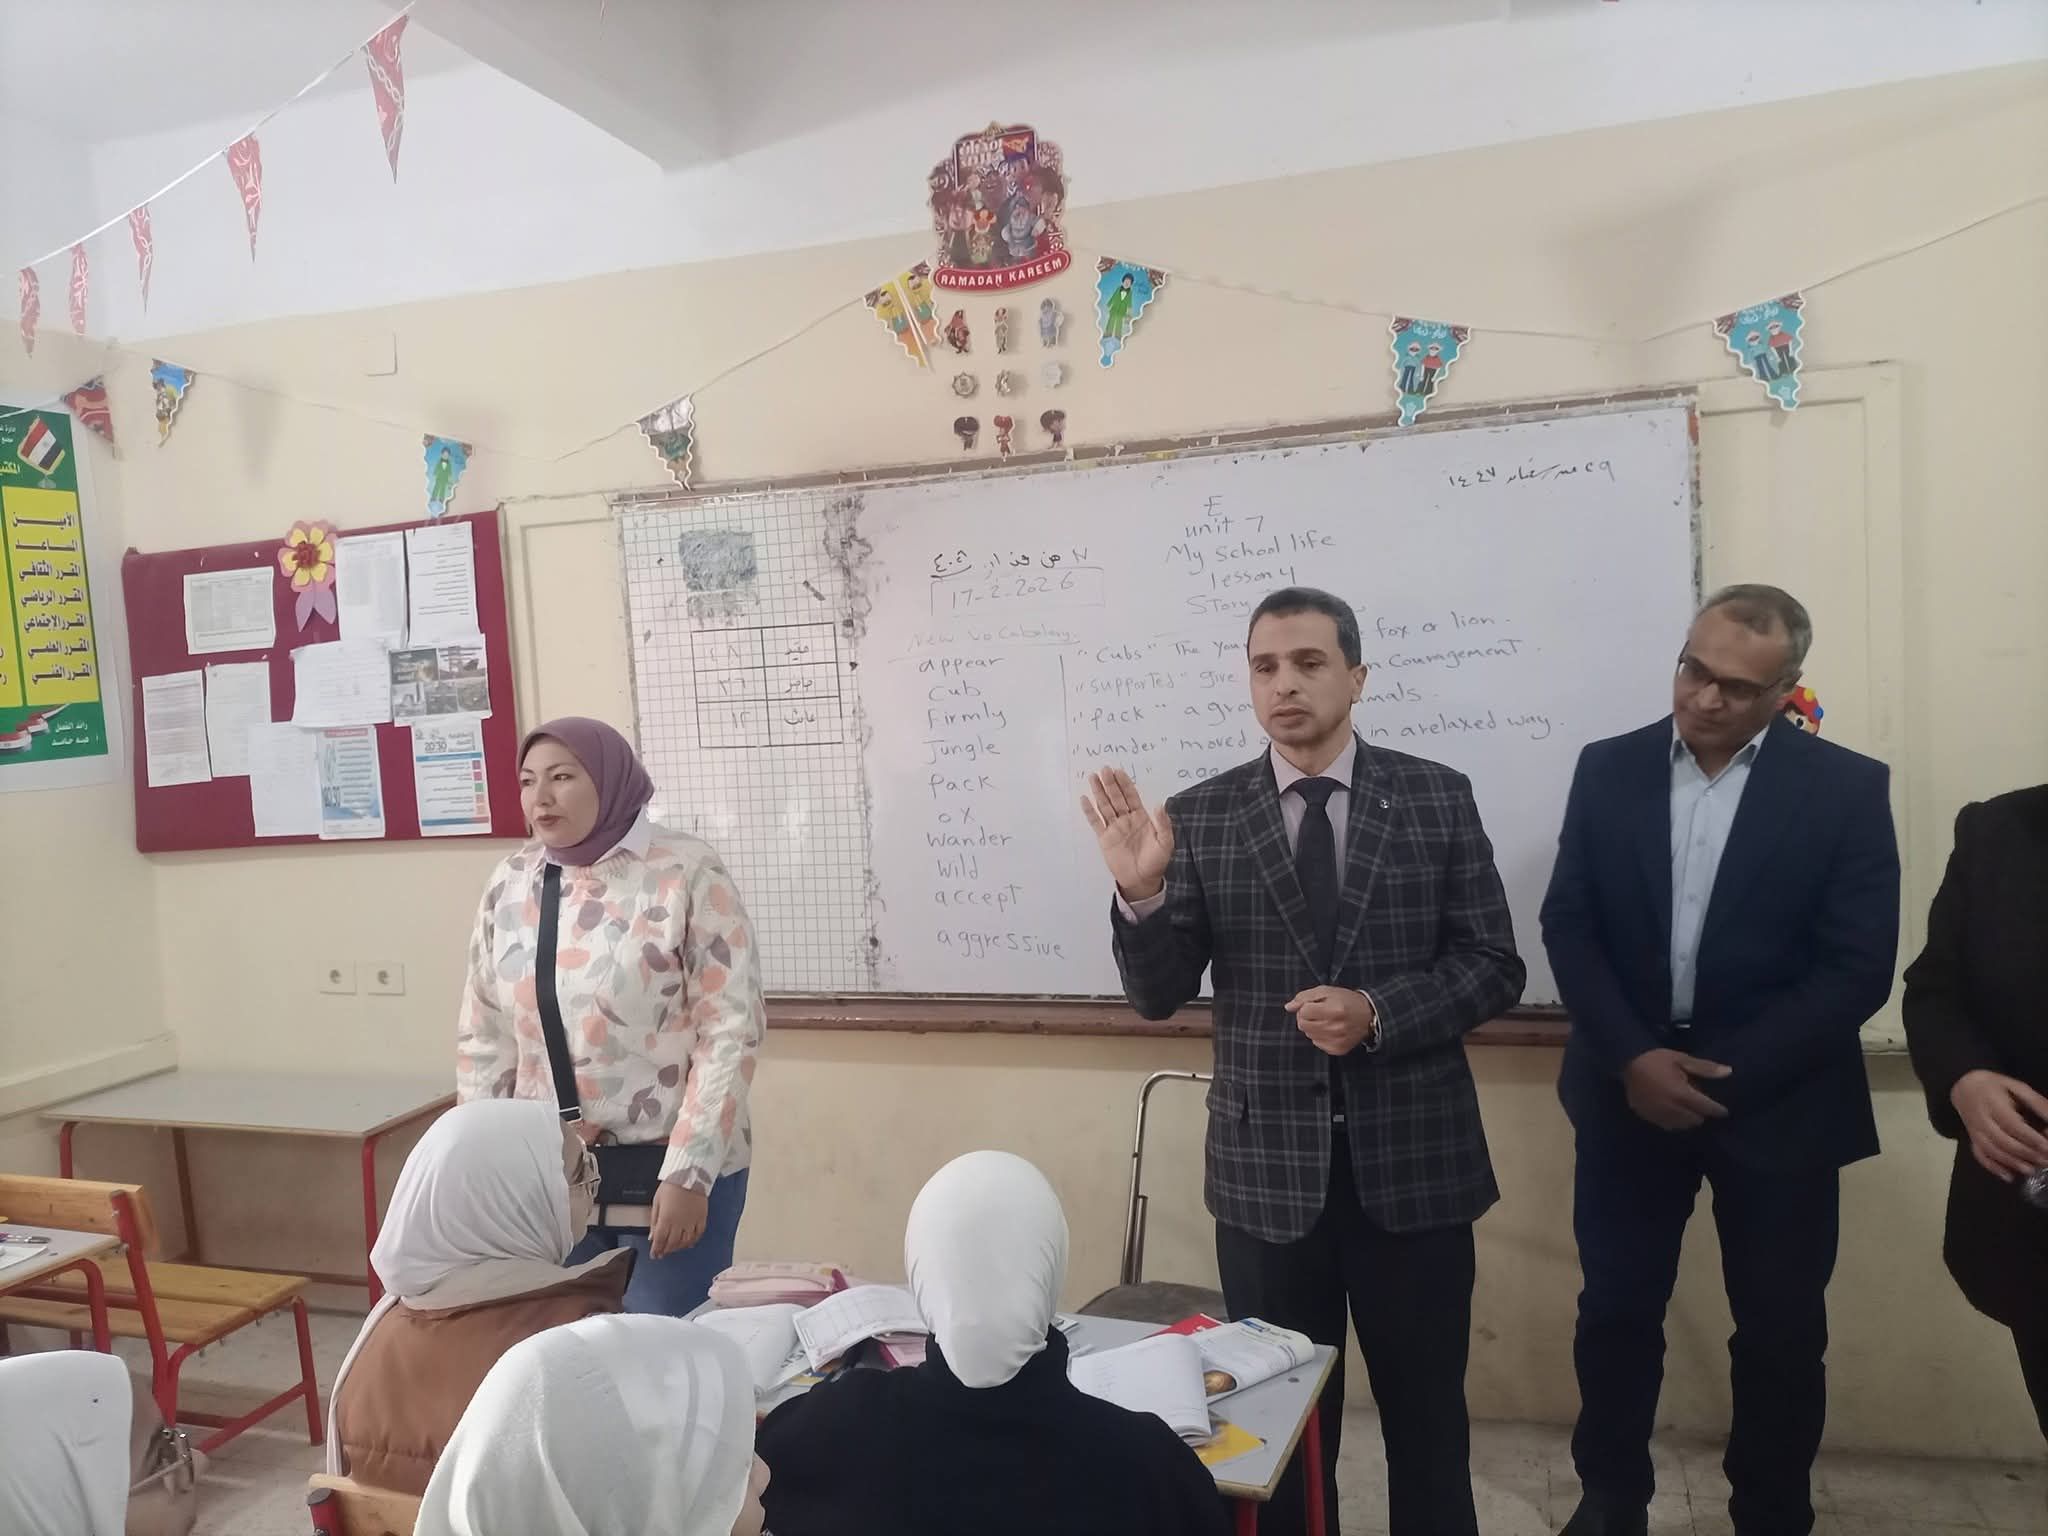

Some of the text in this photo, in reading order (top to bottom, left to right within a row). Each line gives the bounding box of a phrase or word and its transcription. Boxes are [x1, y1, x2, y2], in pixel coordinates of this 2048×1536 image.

[940, 257, 1062, 287] RAMADAN KAREEM
[1245, 514, 1264, 533] 7
[1165, 543, 1204, 576] My
[1290, 529, 1336, 553] life
[1280, 565, 1297, 585] 4
[918, 656, 1005, 677] appear
[1184, 704, 1200, 716] a
[1180, 729, 1247, 751] moved
[934, 884, 1024, 913] accept
[936, 930, 1066, 960] aggressive
